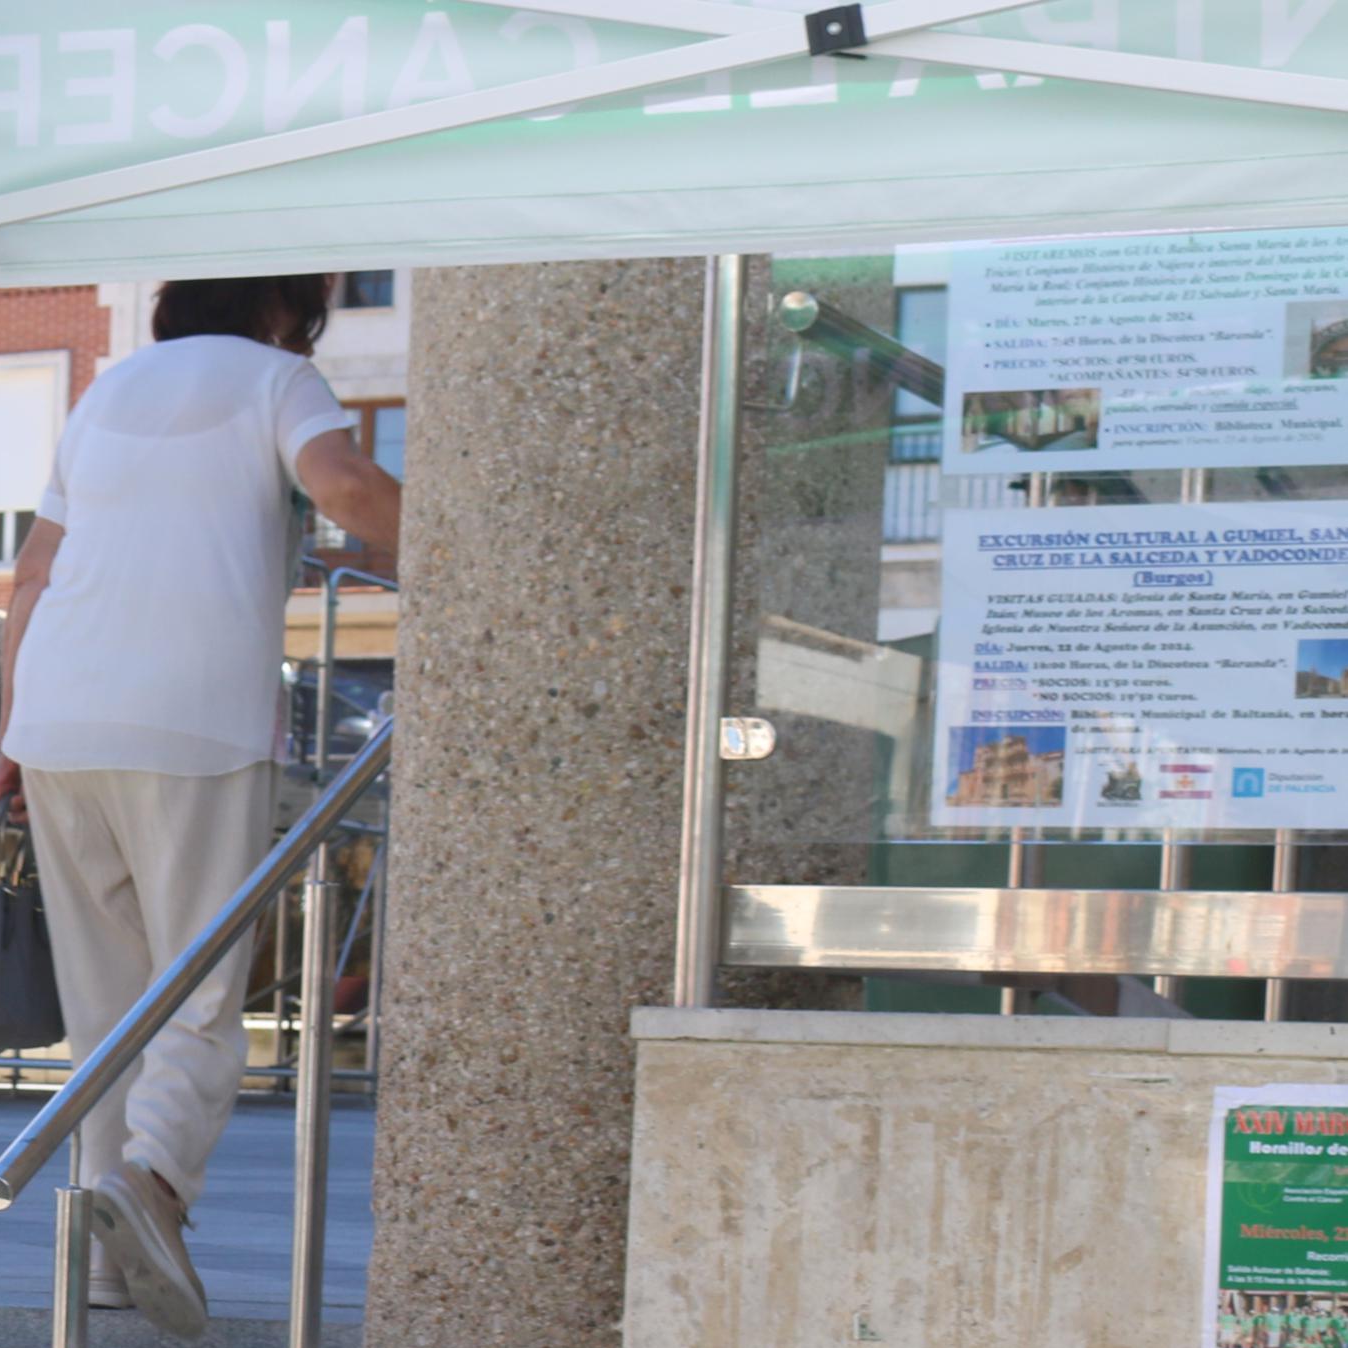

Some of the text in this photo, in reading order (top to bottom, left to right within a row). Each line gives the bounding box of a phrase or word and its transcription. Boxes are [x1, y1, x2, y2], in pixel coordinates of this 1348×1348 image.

[979, 529, 1091, 549] EXCURSIÓN
[1095, 531, 1199, 547] CULTURAL
[1205, 530, 1217, 545] A
[1223, 527, 1304, 545] GUMIEL,
[993, 552, 1045, 569] CRUZ
[1048, 552, 1075, 568] DE
[1080, 551, 1103, 567] LA
[1109, 550, 1199, 566] SALCEDA
[1206, 550, 1219, 564] Y
[1132, 571, 1214, 588] (Burgos)
[1232, 1110, 1288, 1134] XXIV
